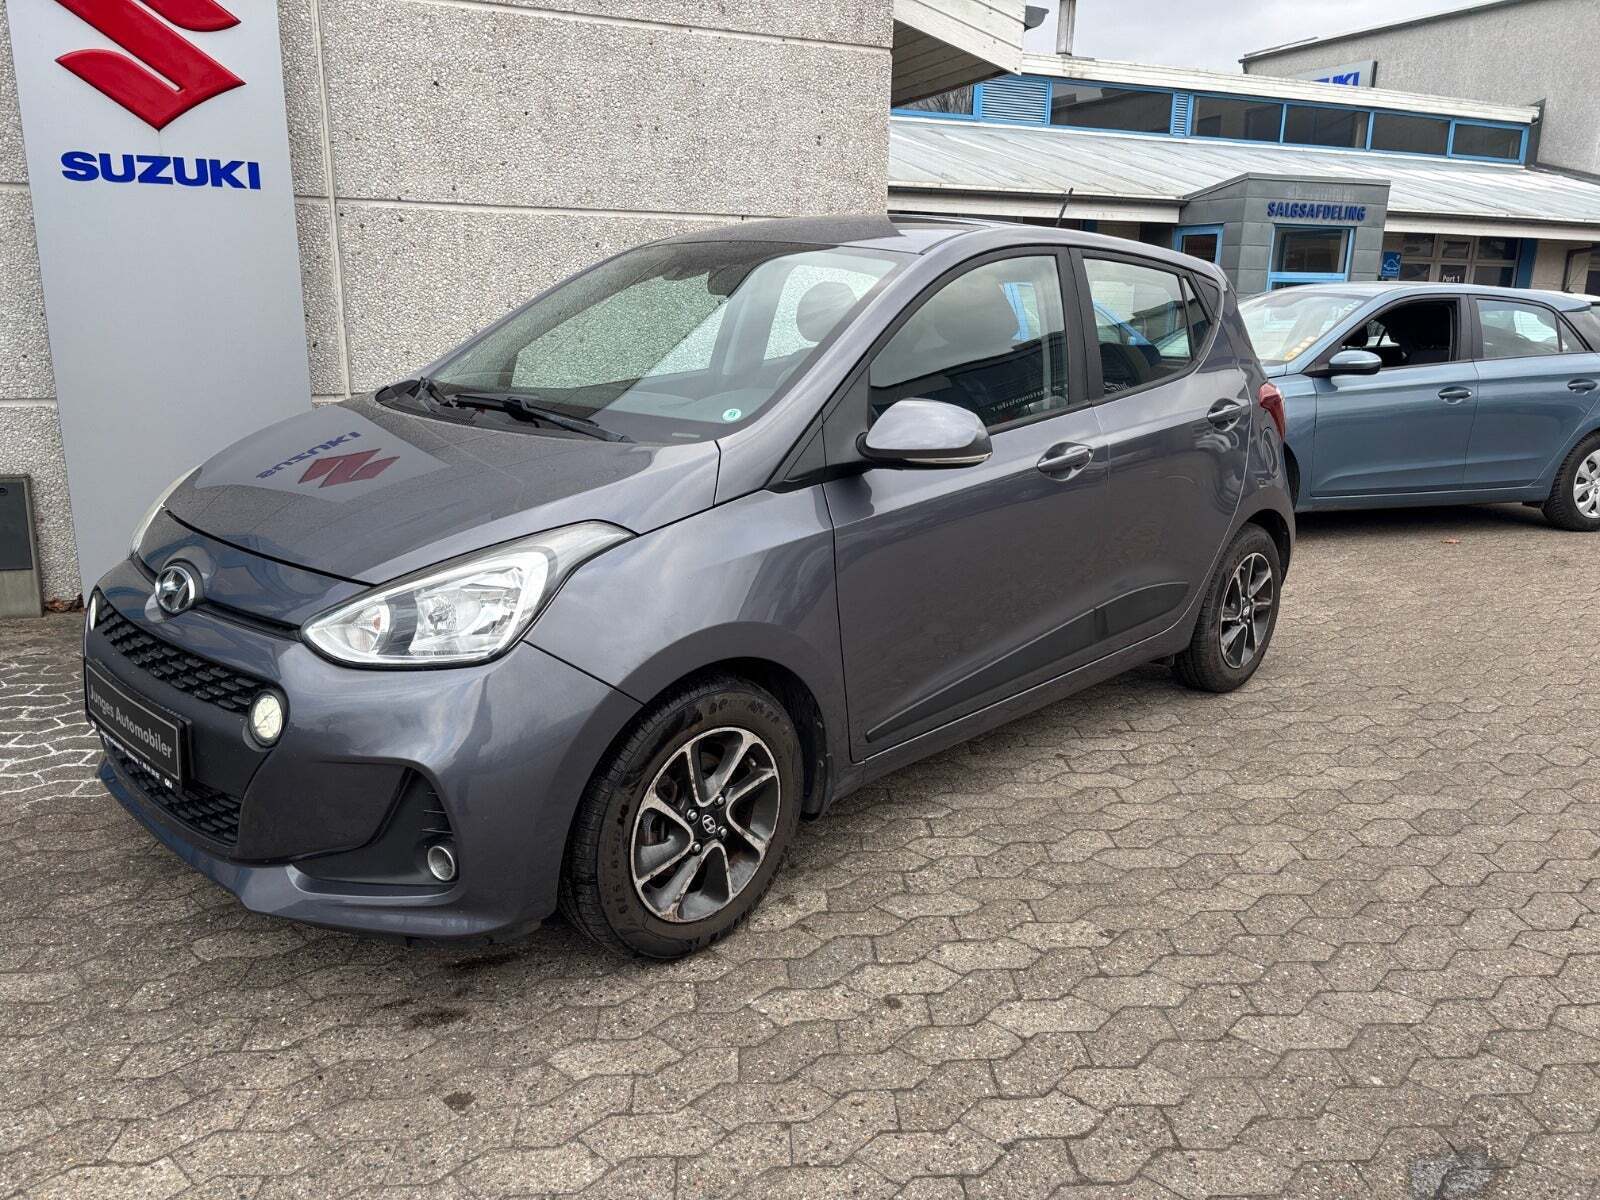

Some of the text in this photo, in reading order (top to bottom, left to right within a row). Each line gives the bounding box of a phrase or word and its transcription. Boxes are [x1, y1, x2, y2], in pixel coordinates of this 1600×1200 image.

[60, 150, 262, 190] SUZUKI
[1267, 201, 1366, 221] SALGSAFDELING
[1443, 274, 1455, 282] Port
[90, 684, 115, 719] Junges
[115, 706, 172, 759] Automobiler
